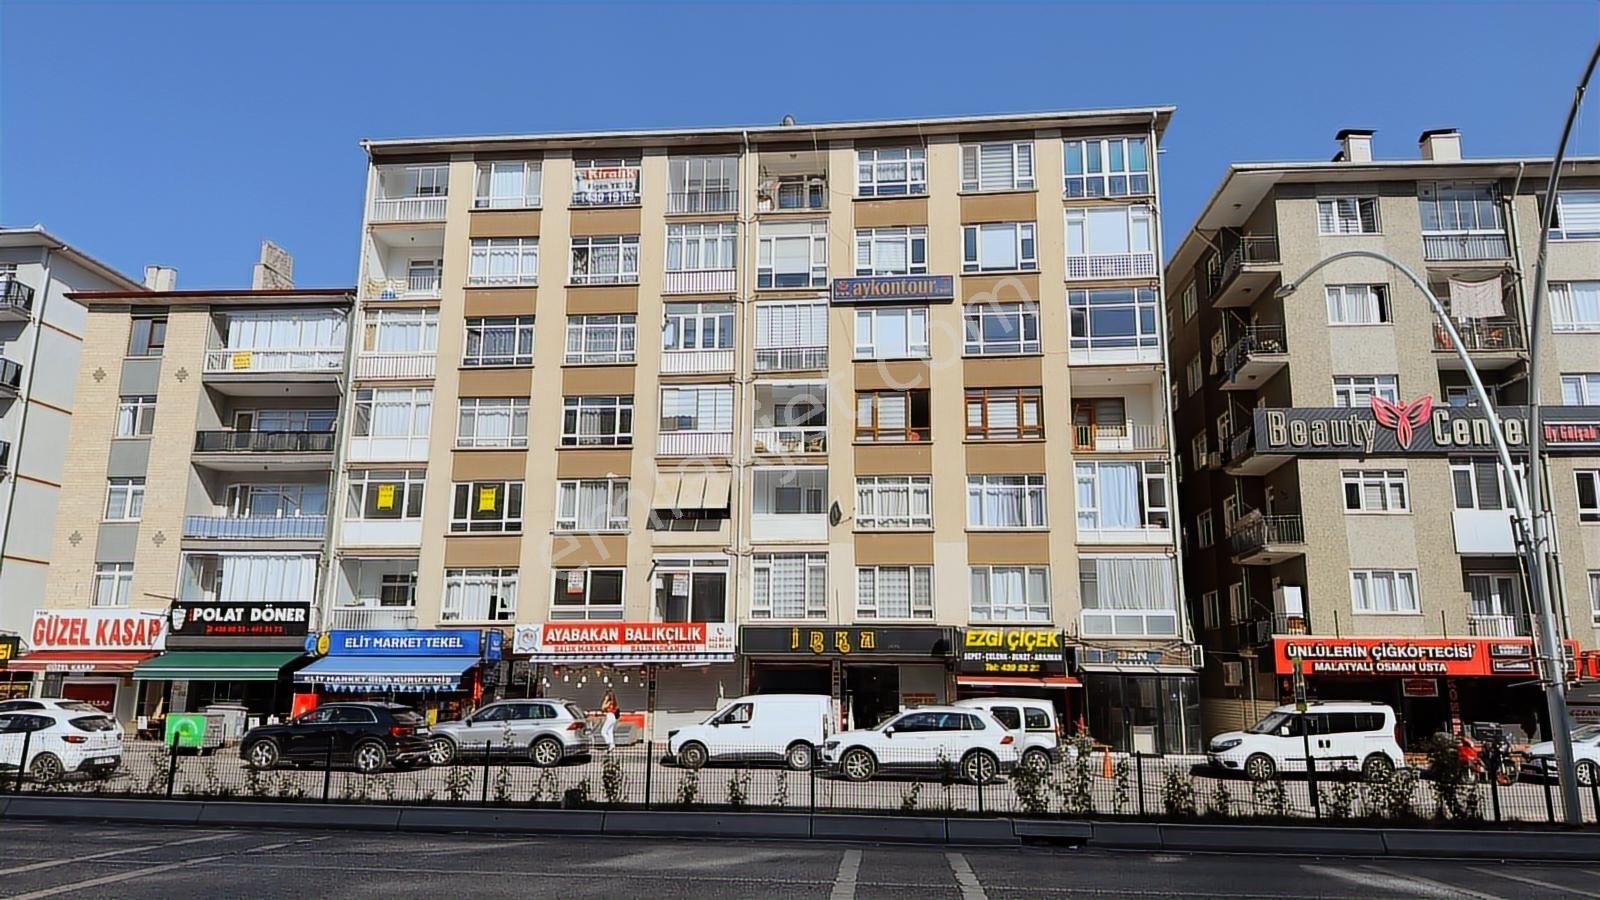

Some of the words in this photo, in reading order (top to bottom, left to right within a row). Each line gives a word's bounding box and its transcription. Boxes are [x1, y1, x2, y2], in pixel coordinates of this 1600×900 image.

[1267, 410, 1376, 453] Beauty
[193, 608, 244, 621] POLAT
[250, 604, 305, 622] DÖNER
[33, 614, 90, 646] GÜZEL
[95, 618, 162, 646] KASAP
[546, 627, 619, 642] AYABAKAN
[625, 627, 702, 644] BALIKÇILIK
[966, 628, 1004, 647] EZGİ
[1007, 627, 1059, 651] ÇİÇEK
[345, 635, 370, 648] ELİT
[373, 637, 423, 648] MARKET
[425, 637, 463, 648] TEKEL
[1287, 644, 1368, 658] ÜNLÜLERİN
[1372, 643, 1472, 661] ÇİĞKÖFTECİSİ
[1315, 662, 1373, 671] MALATYALI
[1377, 663, 1416, 671] OSMAN
[1419, 663, 1447, 672] USTA
